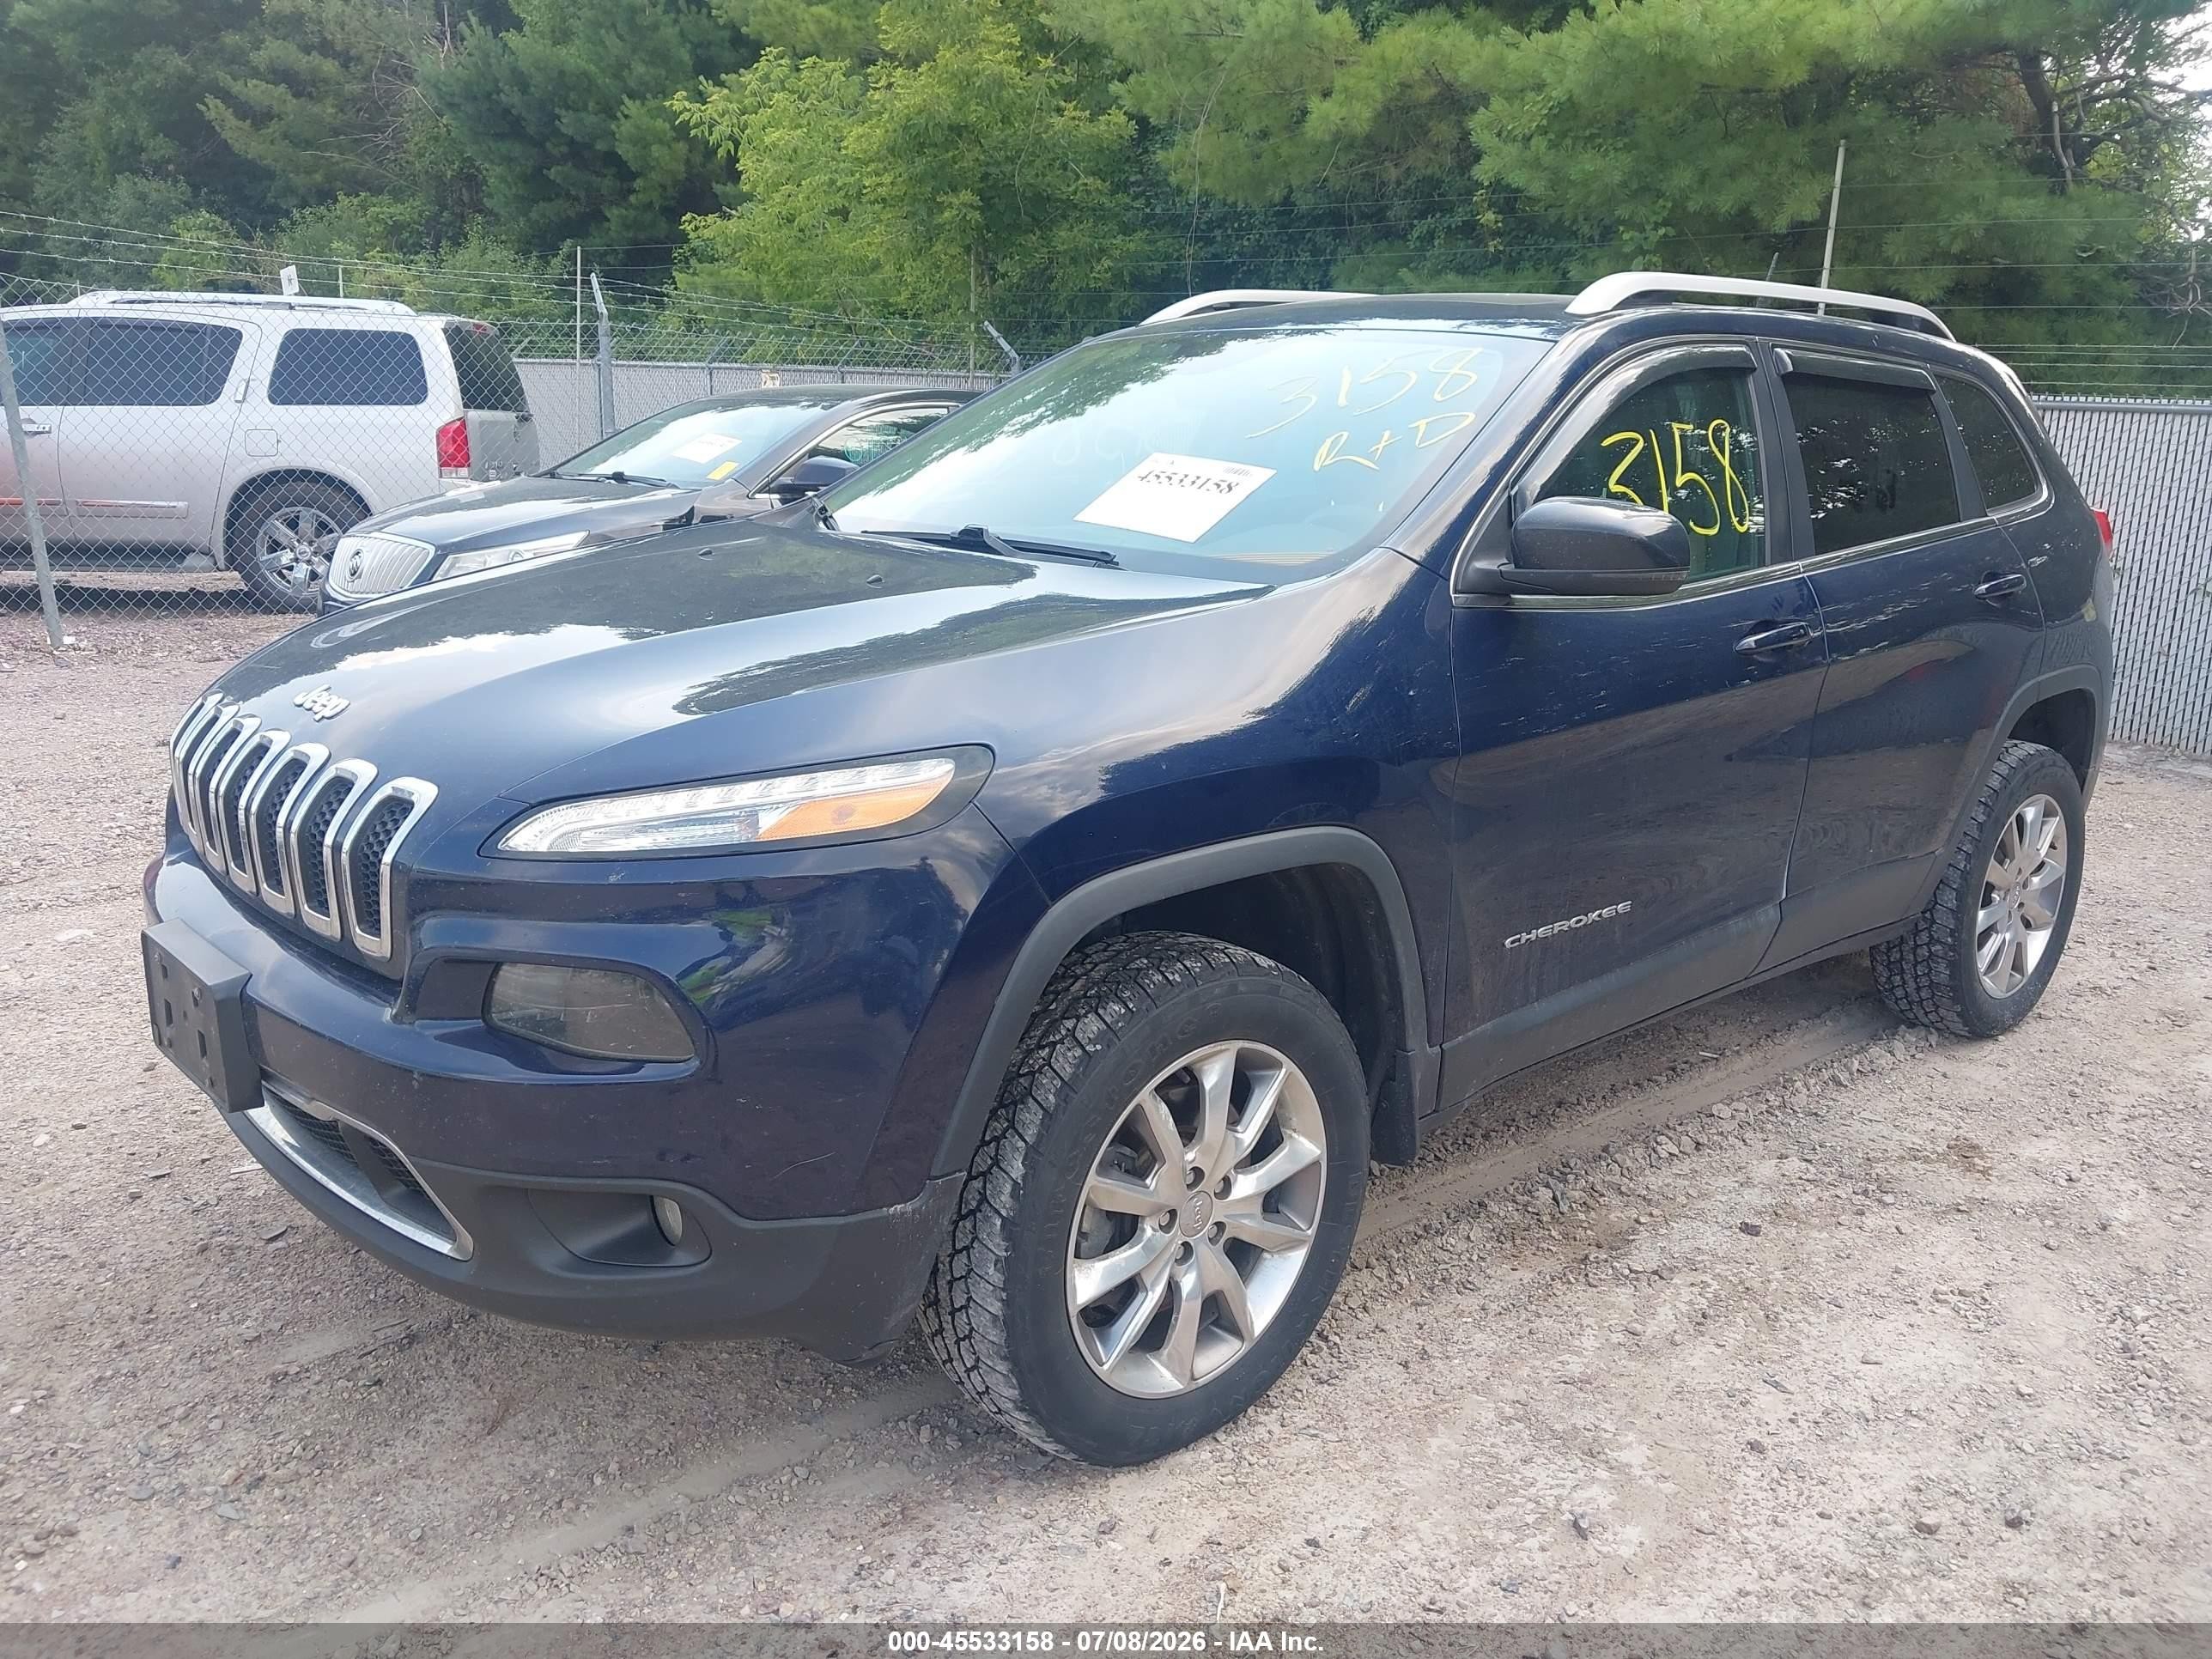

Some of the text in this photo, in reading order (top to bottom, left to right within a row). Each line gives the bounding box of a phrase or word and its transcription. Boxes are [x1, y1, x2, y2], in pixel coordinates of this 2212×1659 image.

[1246, 347, 1483, 440] 3158
[1137, 470, 1239, 495] 45533158
[1601, 418, 1749, 536] 3158
[293, 684, 350, 722] Jeep
[1504, 900, 1632, 949] CHEROKEE
